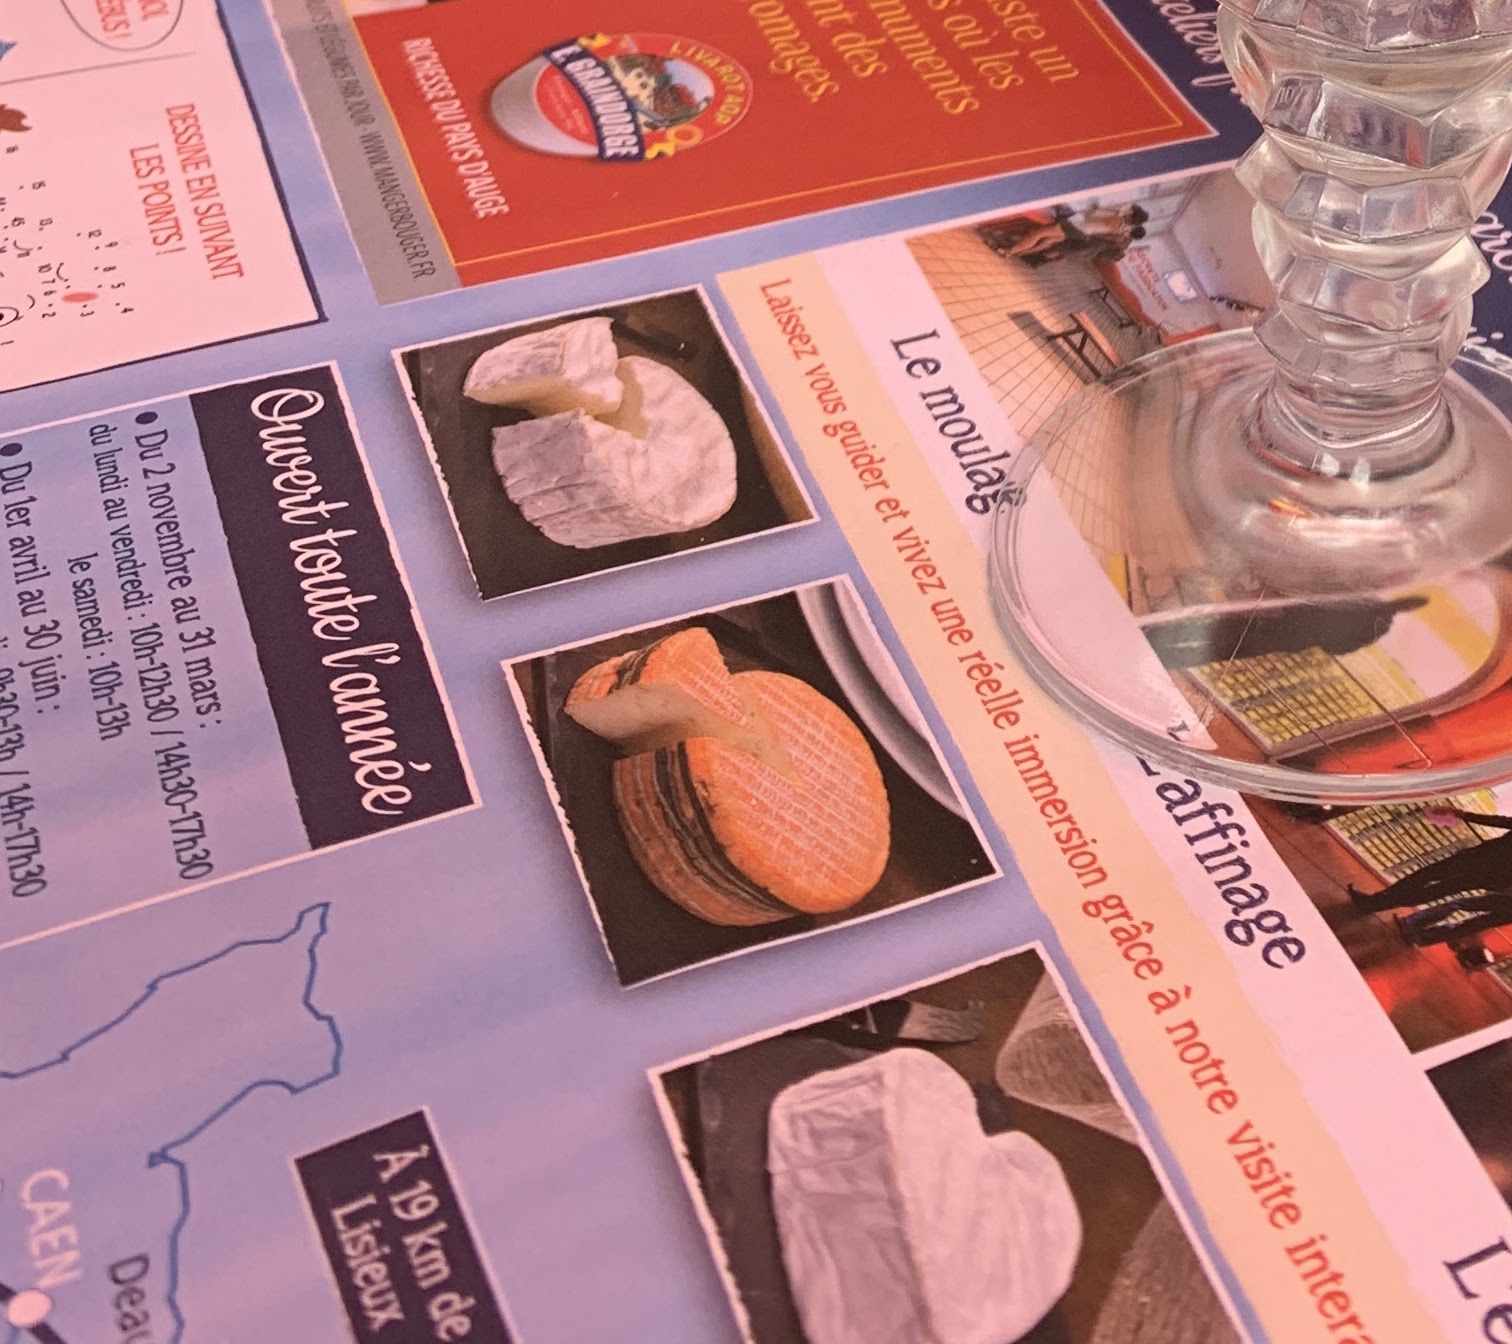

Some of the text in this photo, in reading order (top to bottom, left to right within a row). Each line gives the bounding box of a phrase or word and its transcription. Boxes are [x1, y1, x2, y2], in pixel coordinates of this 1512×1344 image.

[830, 30, 889, 79] des
[941, 13, 999, 50] où
[970, 48, 1025, 92] les
[1027, 44, 1081, 83] un
[402, 36, 511, 221] RICHESSE DU PAYS D'AUGE
[563, 58, 640, 159] GRAINDORGE
[129, 142, 166, 181] LES
[165, 101, 245, 281] DESSINE EN SUIVANT
[137, 179, 185, 249] POINTS
[358, 127, 437, 281] WWW.MANGERBOUGER.FR
[87, 421, 115, 449] du
[133, 426, 170, 462] Du
[887, 326, 1030, 517] Le moulag
[0, 458, 35, 495] Du
[91, 448, 131, 496] lundi
[141, 463, 172, 481] 2
[2, 492, 40, 533] 1er
[102, 496, 131, 525] au
[144, 479, 194, 592] novembre
[8, 534, 52, 590] avril
[66, 549, 99, 575] le
[108, 520, 153, 613] vendredi
[19, 588, 49, 619] au
[71, 572, 112, 650] samedi
[172, 591, 201, 627] au
[249, 385, 434, 816] Ouvert toute l'année
[22, 619, 64, 652] 30
[177, 624, 219, 654] 31
[17, 649, 69, 704] juin
[87, 657, 133, 743] 10h-13h
[128, 620, 181, 730] 10h-12h30
[185, 652, 223, 716] mars
[758, 276, 1304, 1231] Laissez vous guider et vivez une réelle immersion grâce à notre visite
[0, 781, 49, 899] 14h-17h30
[153, 742, 216, 882] 14h30-17h30
[19, 1166, 84, 1290] CAEN
[387, 1178, 442, 1223] 19
[330, 1192, 406, 1335] Lisieux
[401, 1218, 453, 1292] km
[426, 1289, 479, 1344] de
